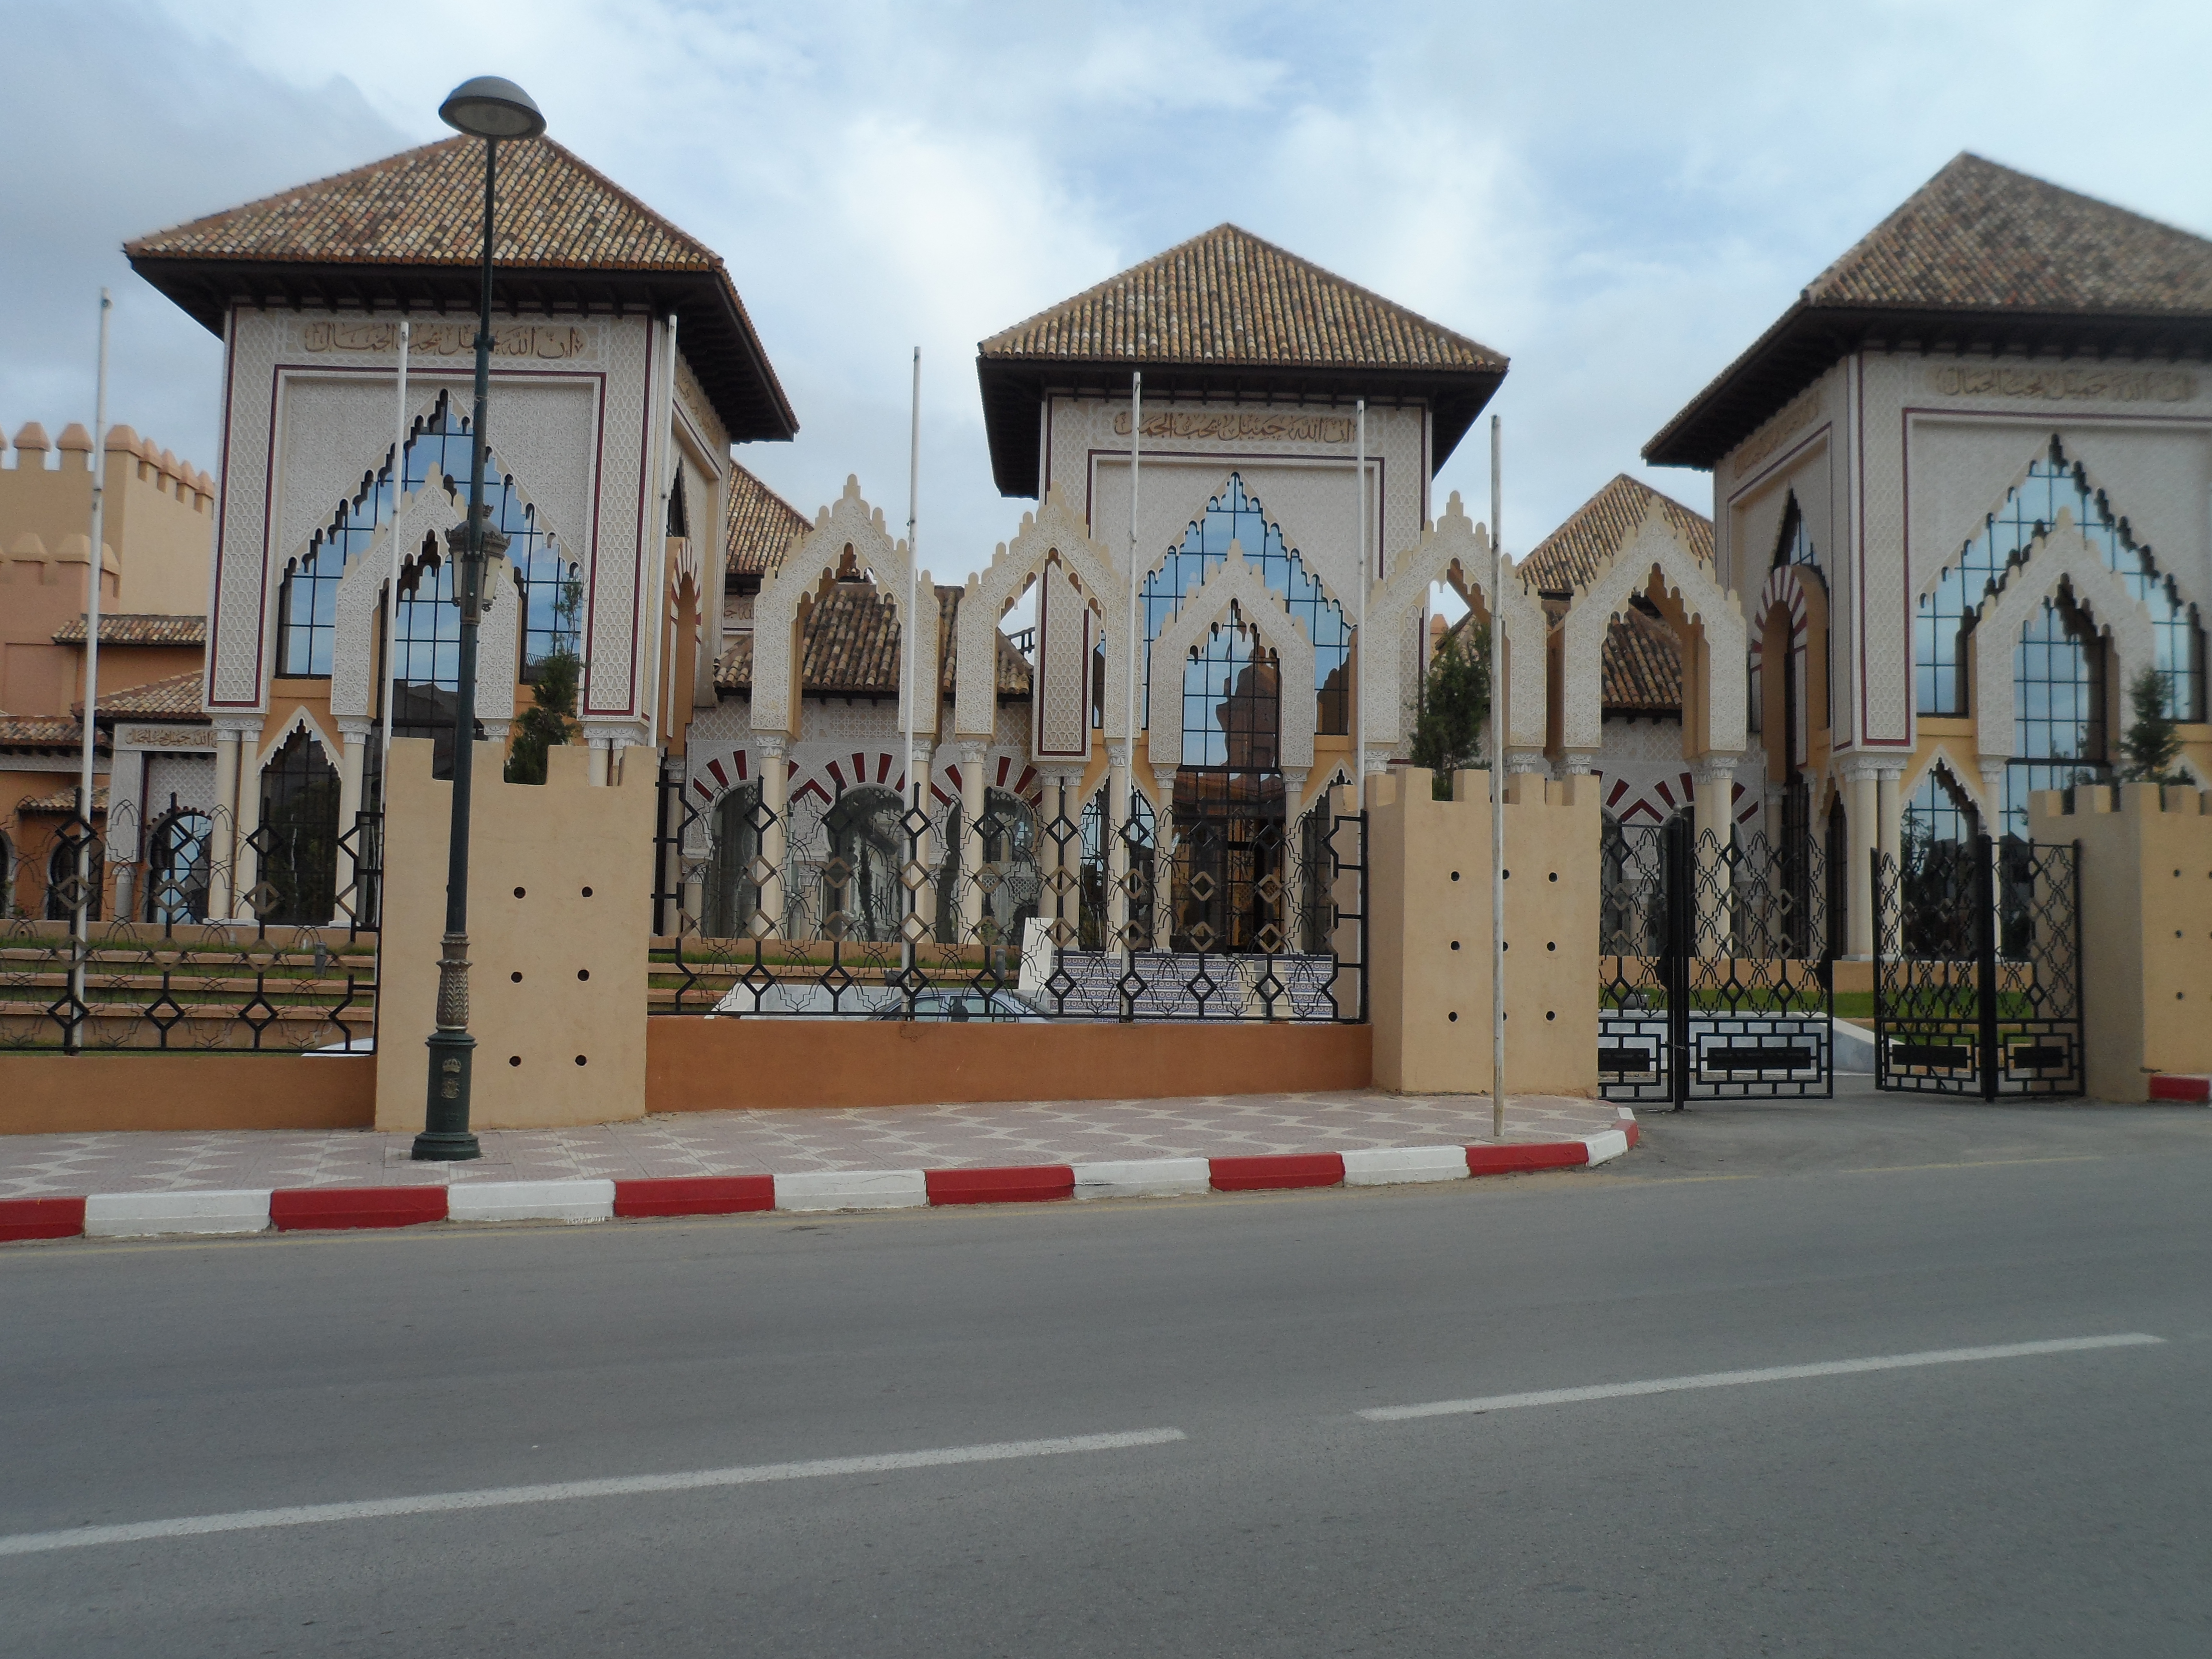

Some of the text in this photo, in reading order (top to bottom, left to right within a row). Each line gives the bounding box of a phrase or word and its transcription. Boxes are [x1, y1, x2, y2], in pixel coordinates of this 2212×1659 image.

[305, 322, 396, 352] الجمال
[501, 325, 537, 356] الله
[1114, 411, 1173, 440] الجمل
[1217, 414, 1287, 442] جميل
[1287, 416, 1323, 443] الله
